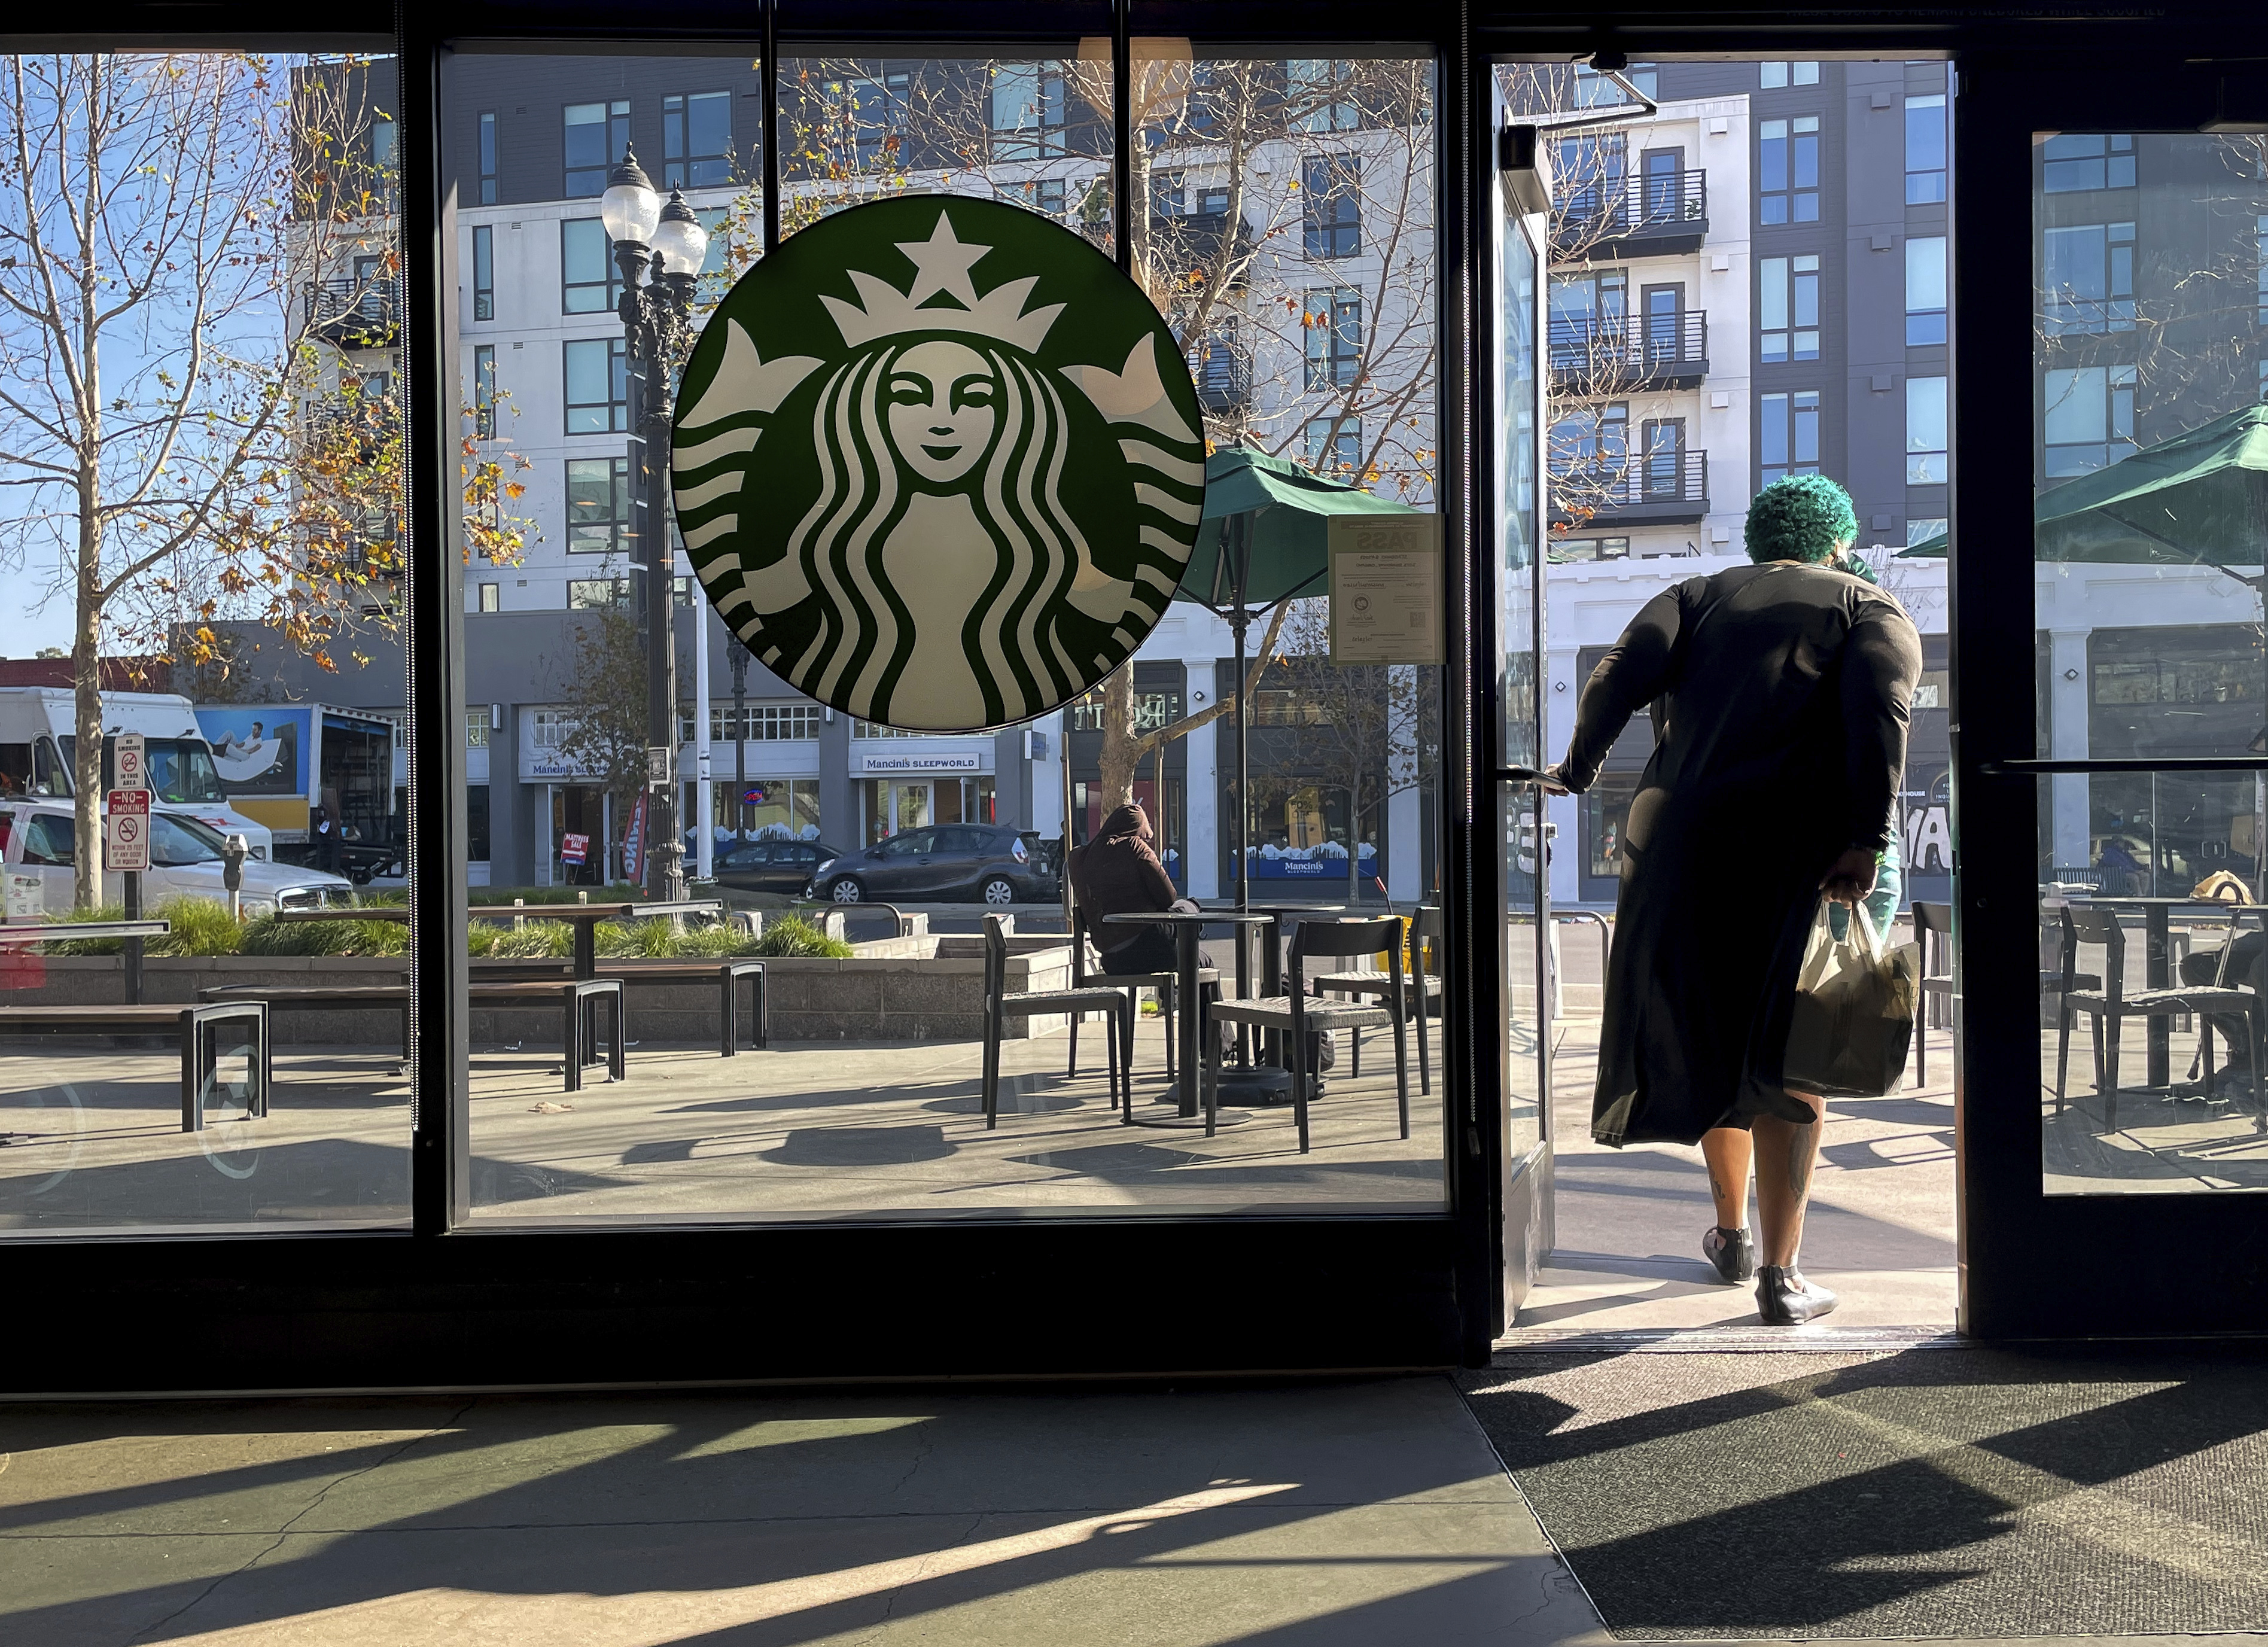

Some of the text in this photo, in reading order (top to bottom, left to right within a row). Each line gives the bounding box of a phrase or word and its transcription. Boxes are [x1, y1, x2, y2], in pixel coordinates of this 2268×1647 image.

[912, 759, 975, 768] SLEEPWORLD
[121, 791, 136, 803] NO
[112, 803, 145, 814] SMOKING
[565, 833, 590, 843] MATTRESS
[571, 840, 583, 849] SALE
